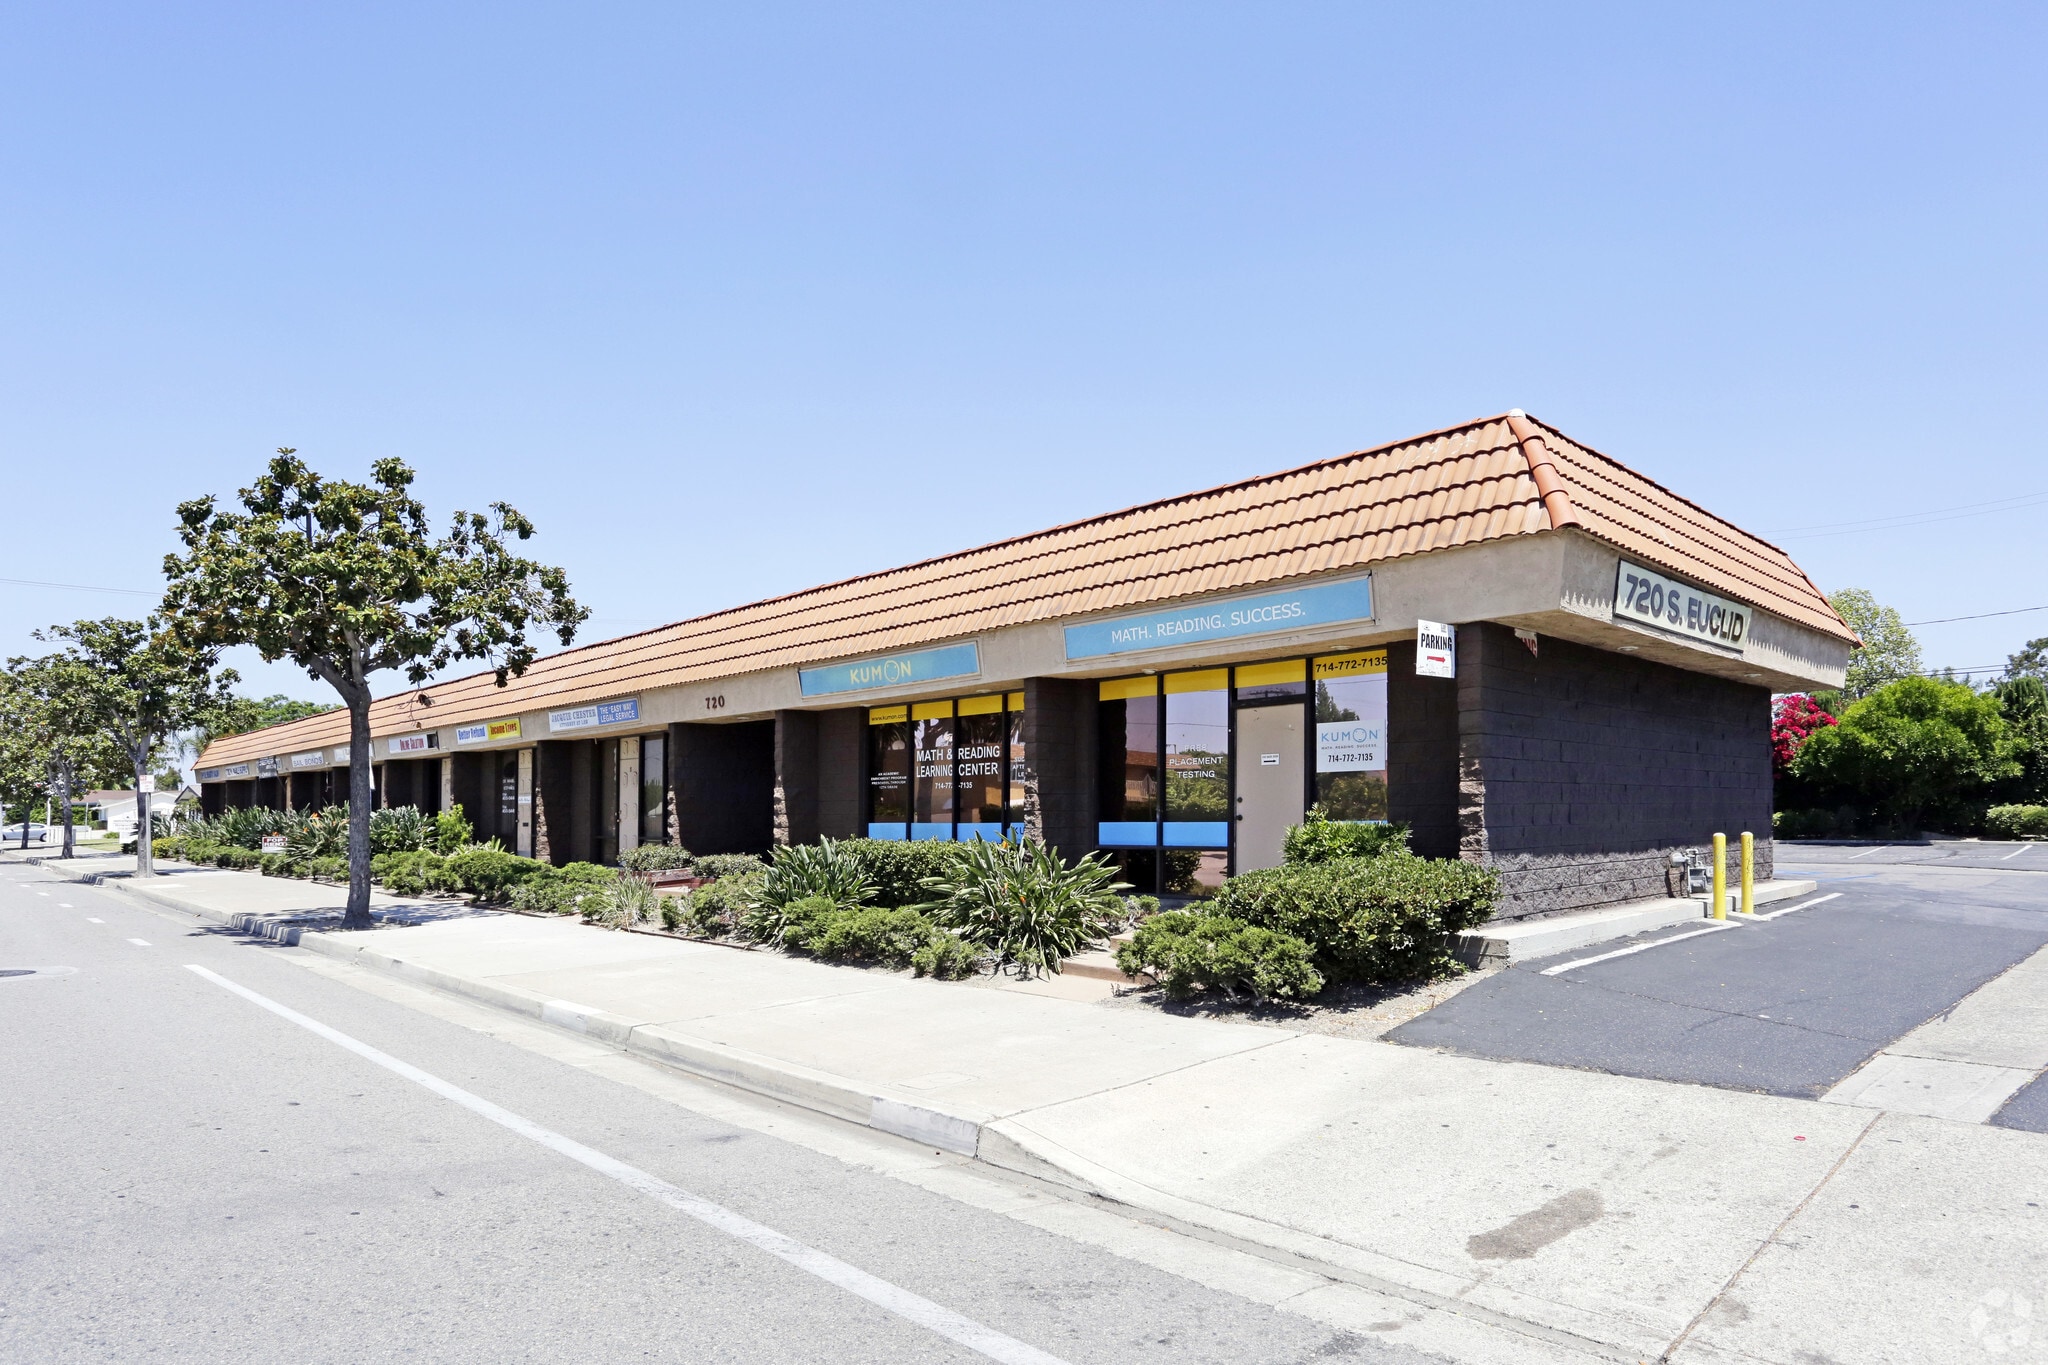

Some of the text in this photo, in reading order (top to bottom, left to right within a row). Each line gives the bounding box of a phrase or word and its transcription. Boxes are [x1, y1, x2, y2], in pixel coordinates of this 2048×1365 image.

[1625, 573, 1744, 644] 720 S. EUCLID
[1111, 602, 1306, 643] MATH. READING. SUCCESS.
[1420, 632, 1452, 652] PARKING
[850, 659, 912, 685] KUMON
[1315, 656, 1388, 673] 714-772-7135
[705, 695, 725, 709] 720
[573, 708, 596, 719] CHESTER
[600, 710, 635, 723] LEGAL SERVICE
[1321, 727, 1378, 743] KUMON
[916, 749, 944, 762] MATH
[946, 748, 953, 760] &
[958, 745, 1000, 760] READING
[1184, 744, 1207, 752] FREE
[1169, 756, 1223, 766] PLACEMENT
[1328, 753, 1373, 763] 714-772-7135
[916, 762, 998, 778] LEARNING CENTER
[1177, 770, 1215, 779] TESTING
[935, 781, 973, 790] 714-77-7135
